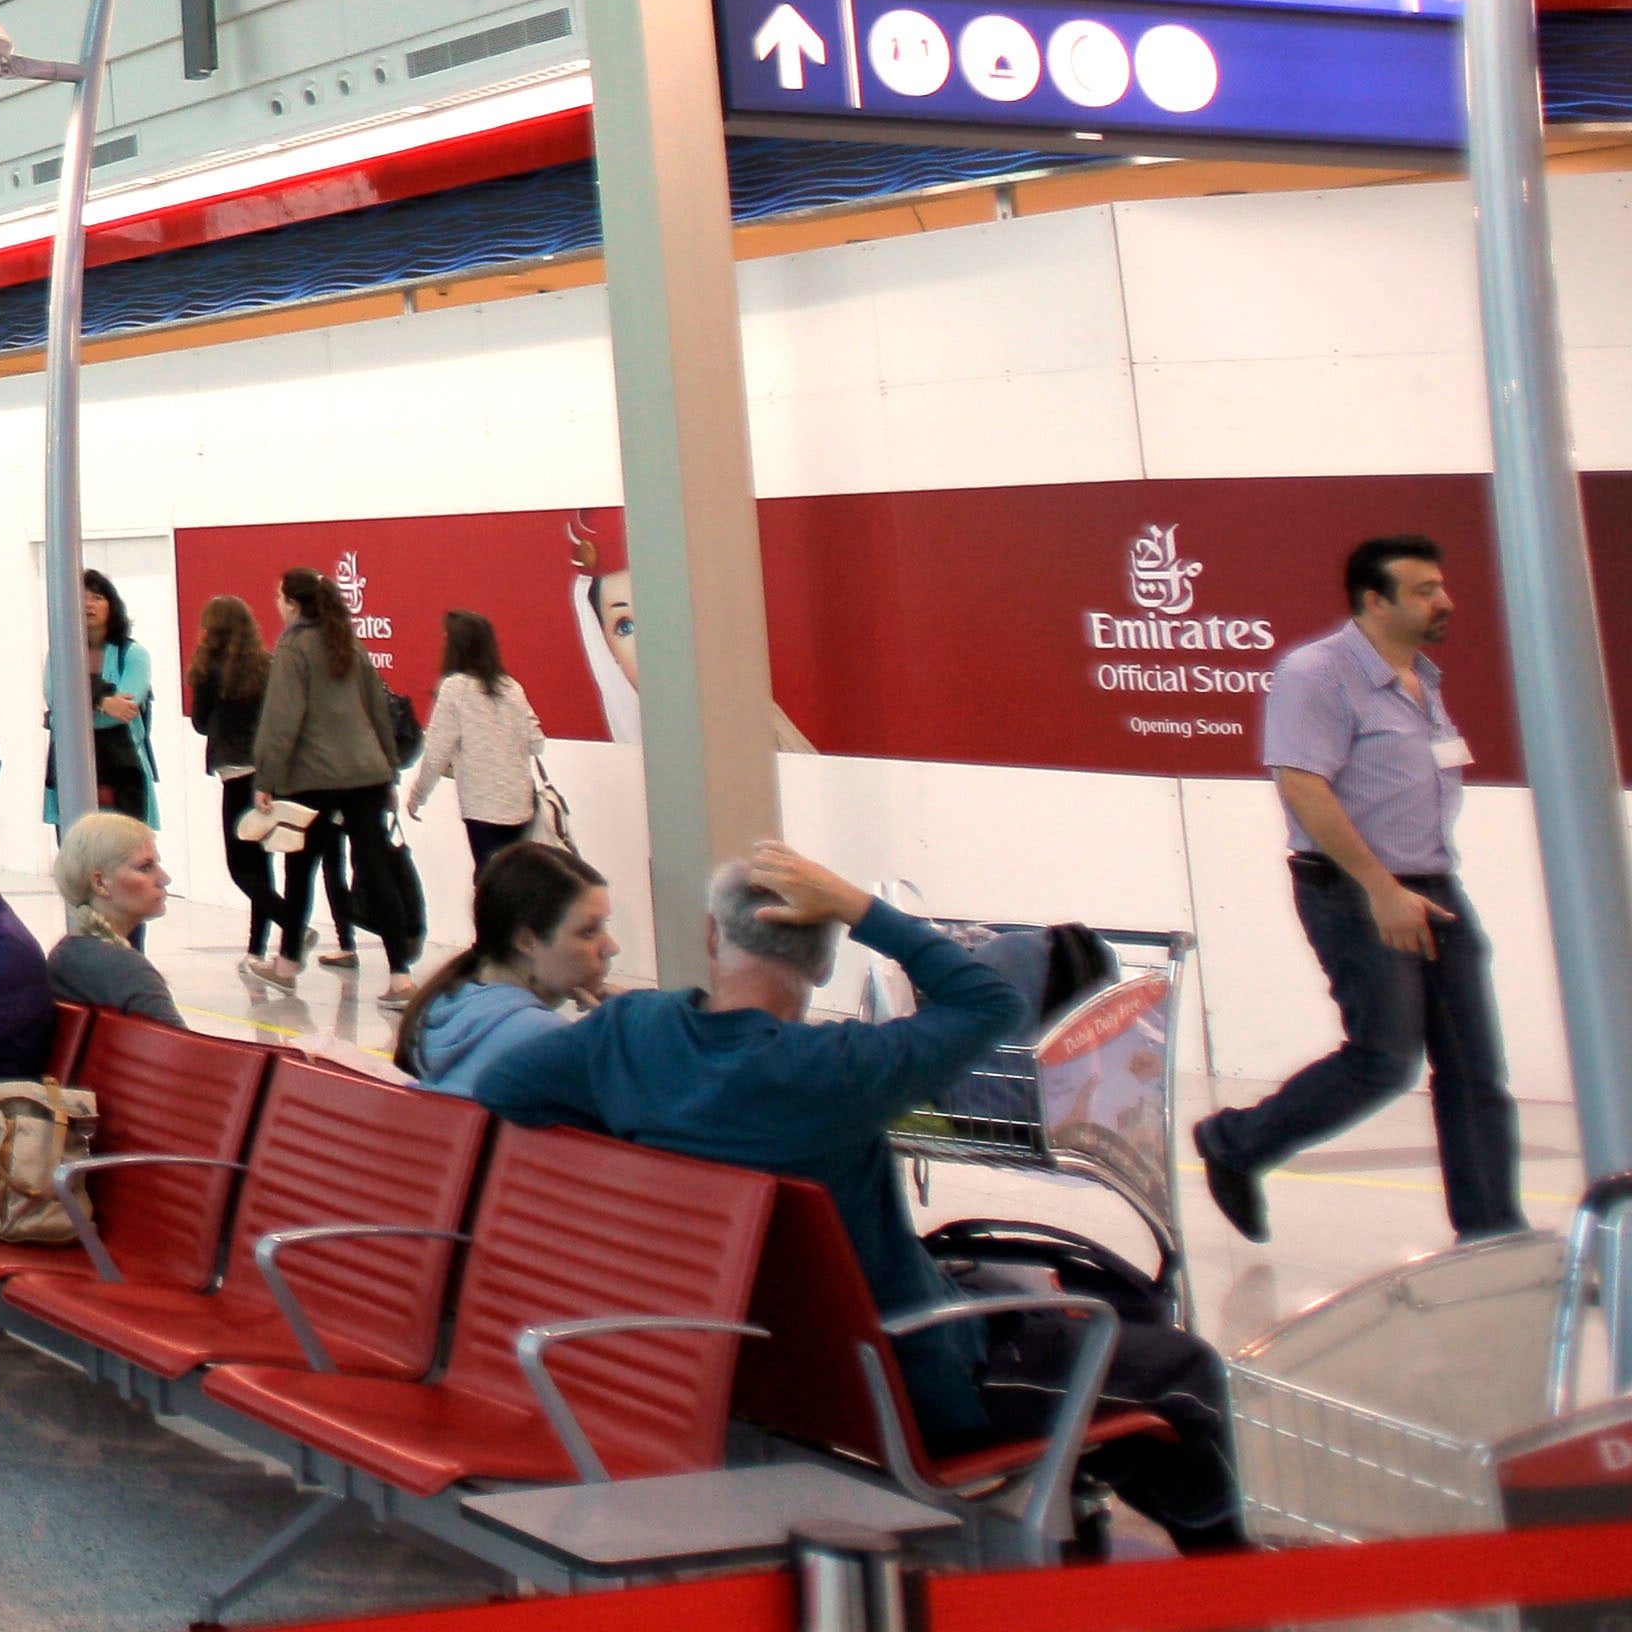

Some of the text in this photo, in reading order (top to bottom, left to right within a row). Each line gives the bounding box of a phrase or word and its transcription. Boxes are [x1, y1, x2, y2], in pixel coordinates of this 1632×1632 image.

[1089, 612, 1275, 650] Emirates
[1098, 664, 1187, 692] Official
[1131, 717, 1243, 738] Opening Soon
